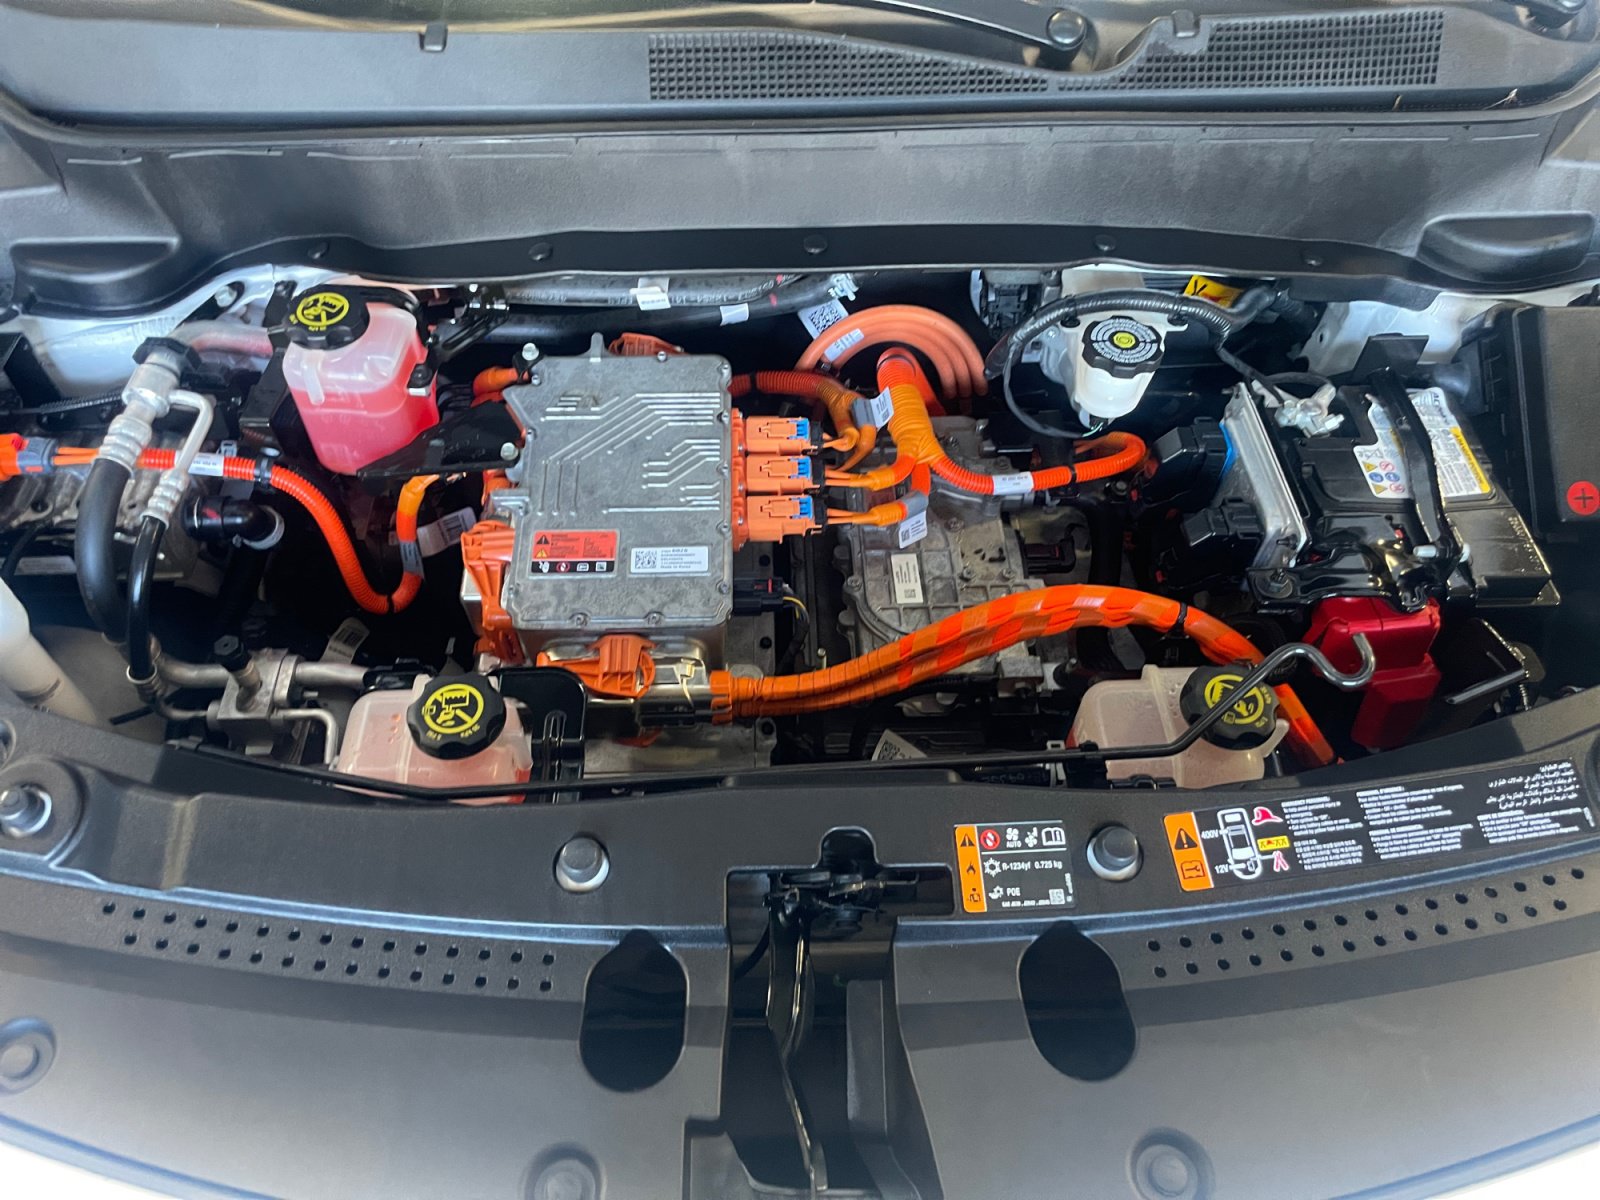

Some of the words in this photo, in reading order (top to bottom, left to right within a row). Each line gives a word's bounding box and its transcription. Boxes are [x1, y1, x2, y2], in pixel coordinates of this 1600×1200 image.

[1201, 829, 1219, 839] 400V
[1002, 861, 1031, 871] R-1234yf
[1053, 860, 1063, 870] kg
[1214, 864, 1229, 874] 12V
[1006, 887, 1021, 897] POE
